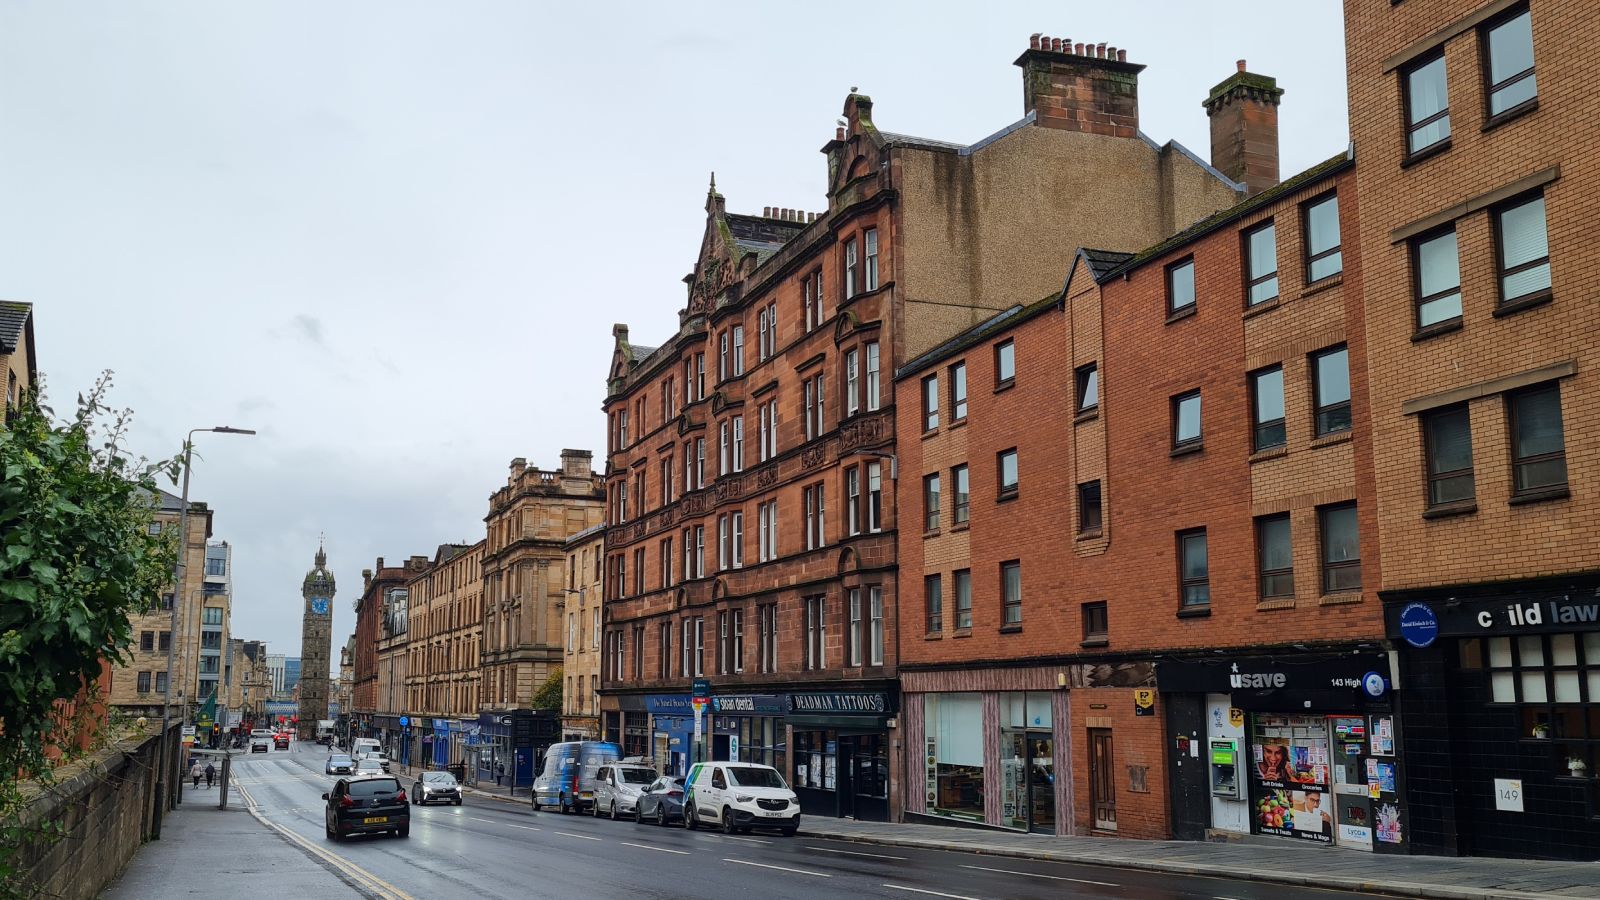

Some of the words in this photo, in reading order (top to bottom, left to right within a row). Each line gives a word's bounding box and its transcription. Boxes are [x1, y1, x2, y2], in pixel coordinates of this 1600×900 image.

[1550, 601, 1599, 624] law
[1230, 672, 1287, 689] usave
[1331, 678, 1344, 687] 143
[1345, 678, 1362, 688] High
[720, 697, 736, 711] sloan
[735, 697, 755, 711] dental
[795, 695, 833, 710] DEADMAN
[834, 695, 876, 710] TATTOOS
[1500, 789, 1519, 801] 149
[1301, 831, 1313, 839] News
[1318, 834, 1330, 842] Mags
